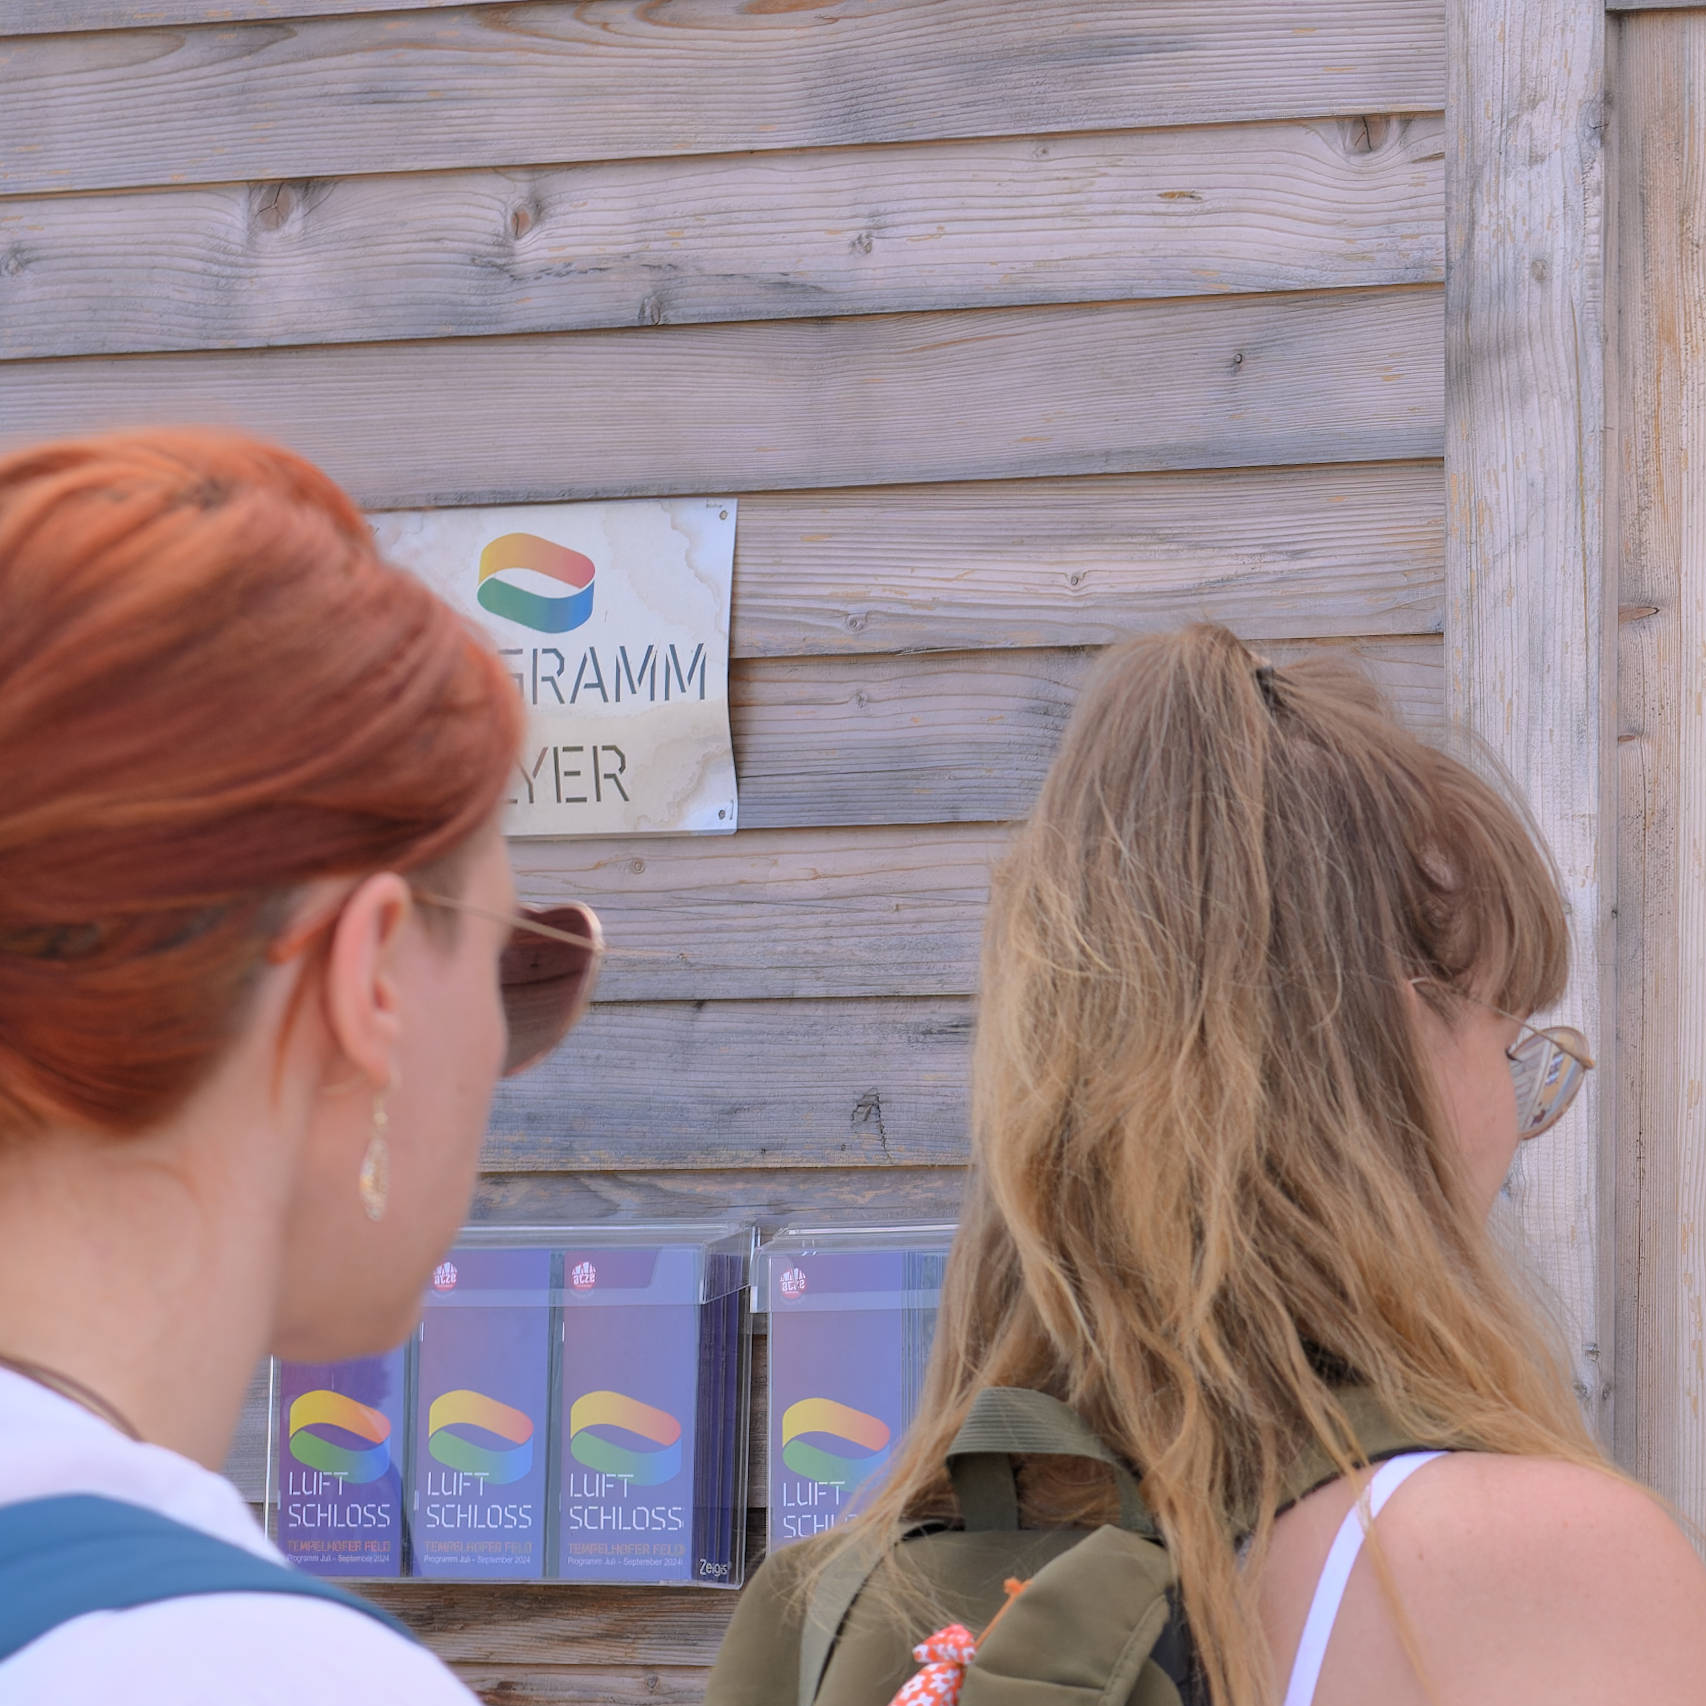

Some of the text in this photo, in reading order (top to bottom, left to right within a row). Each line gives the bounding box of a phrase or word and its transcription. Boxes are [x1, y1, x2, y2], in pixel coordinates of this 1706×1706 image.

[505, 745, 630, 804] YER
[288, 1471, 349, 1496] LUFT
[427, 1471, 489, 1496] LUFT
[569, 1473, 634, 1497] LUFT
[784, 1481, 845, 1507] LUFT
[288, 1503, 391, 1528] SCHLOSS
[426, 1503, 532, 1529] SCHLOSS
[569, 1506, 683, 1531] SCHLOSS
